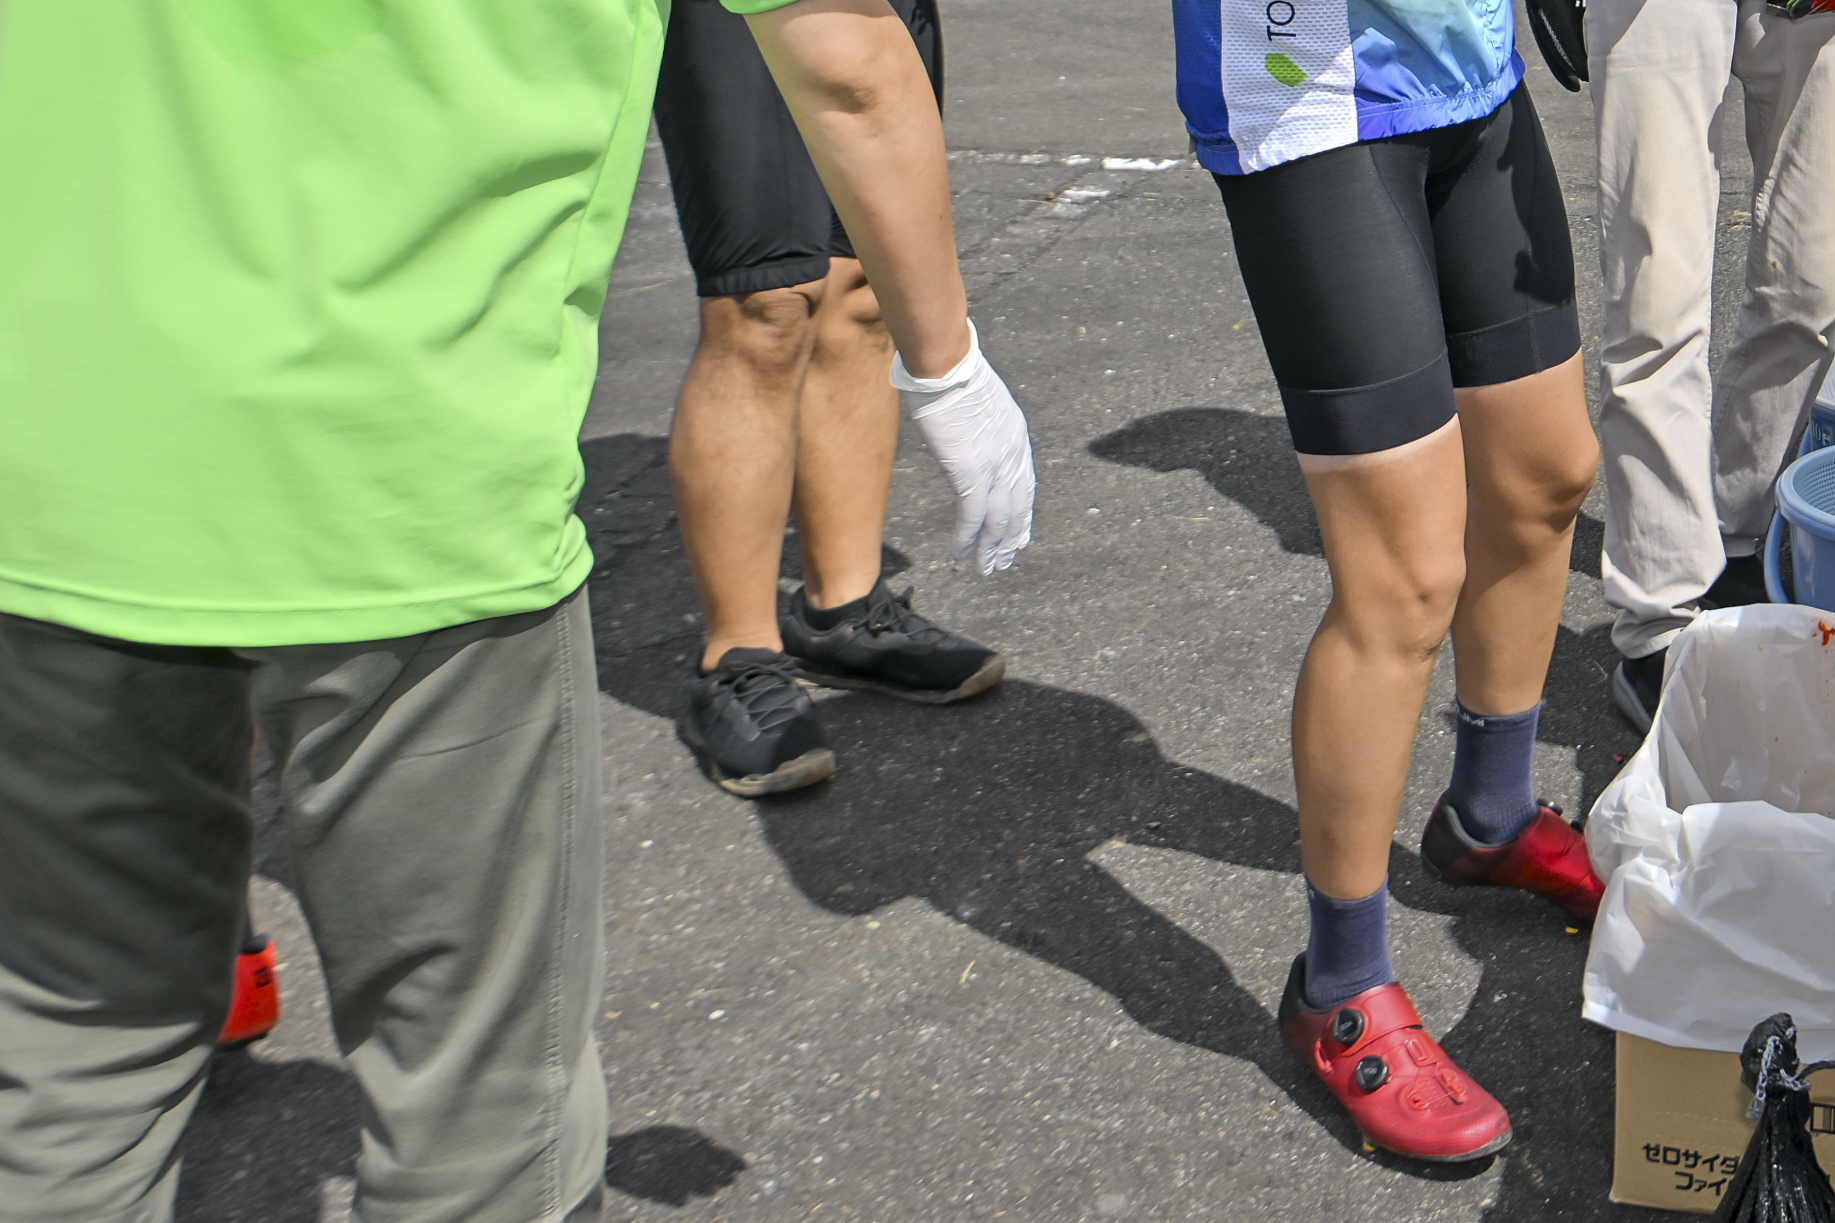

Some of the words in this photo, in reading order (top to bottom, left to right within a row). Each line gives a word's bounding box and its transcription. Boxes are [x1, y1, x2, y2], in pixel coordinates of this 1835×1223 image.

[1643, 1143, 1740, 1174] ゼロサイダ
[1675, 1171, 1727, 1196] ファイ
